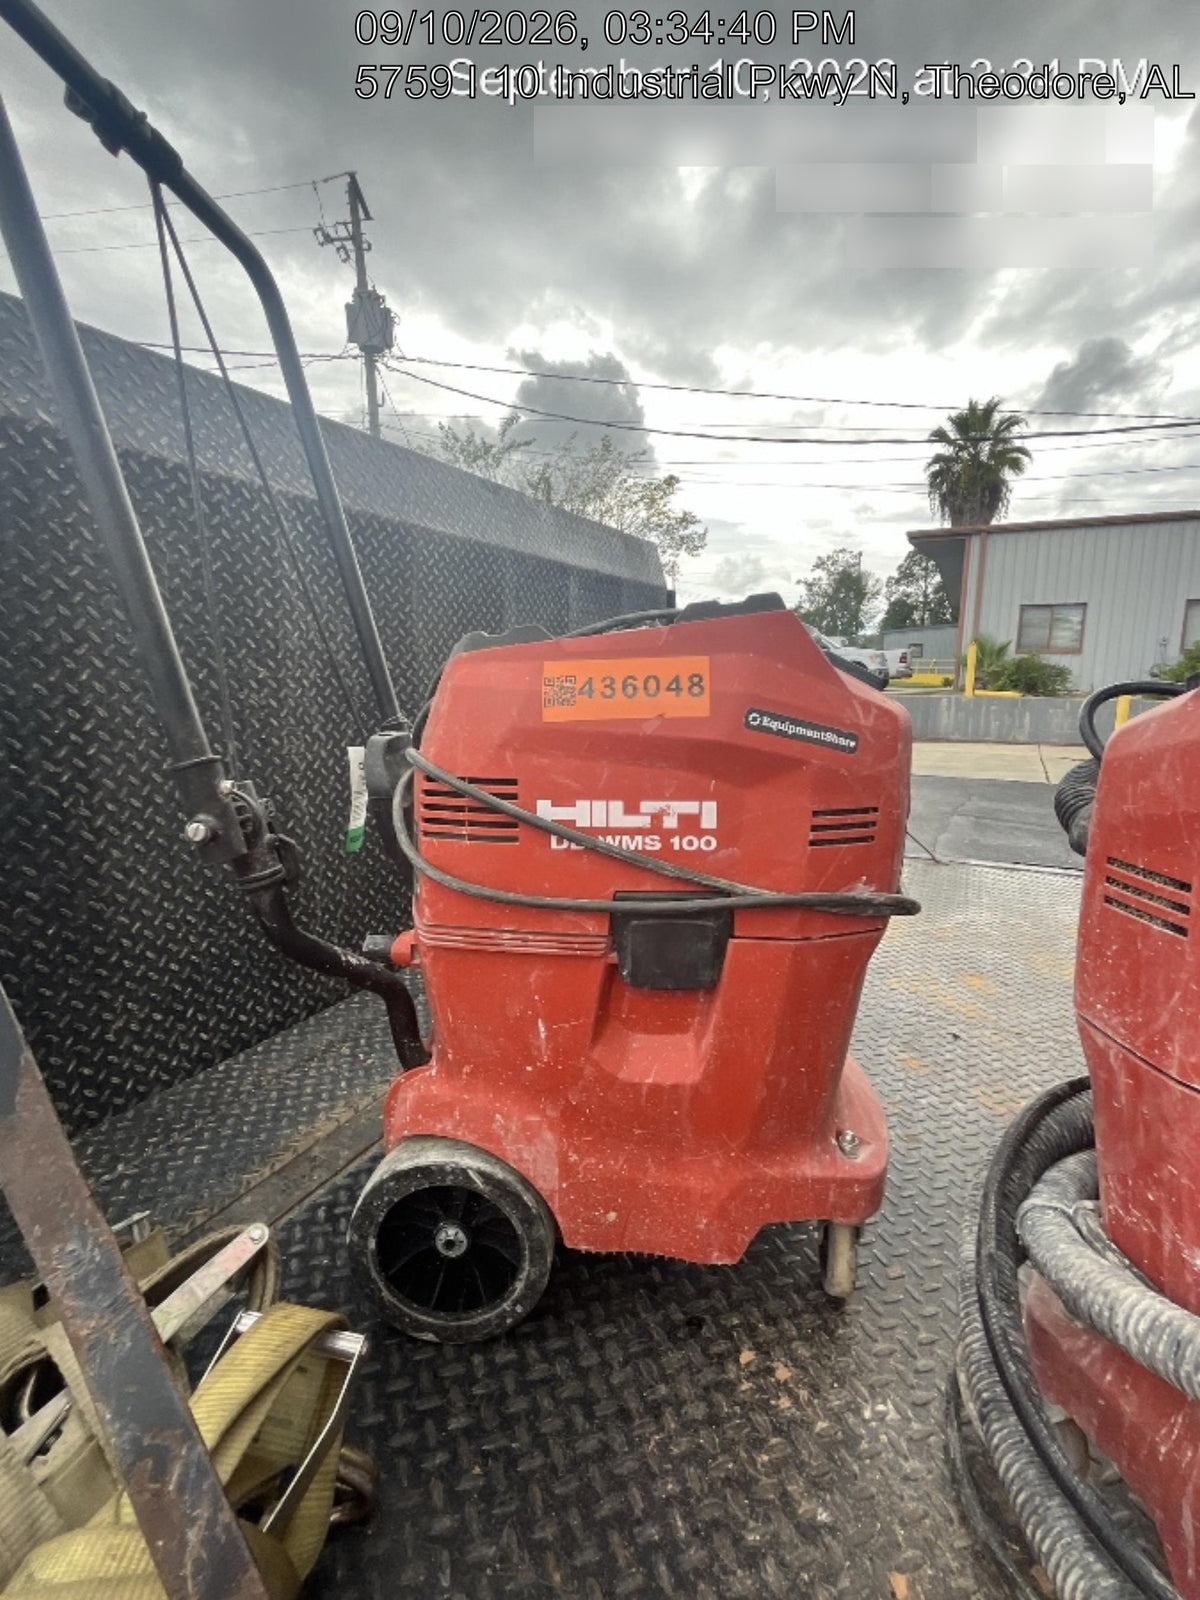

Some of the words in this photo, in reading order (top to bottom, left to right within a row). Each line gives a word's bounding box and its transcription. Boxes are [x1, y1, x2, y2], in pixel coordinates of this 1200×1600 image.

[578, 673, 705, 699] 436048
[761, 715, 857, 748] EquipmentShare
[536, 799, 718, 829] HILTI
[669, 834, 718, 851] 100
